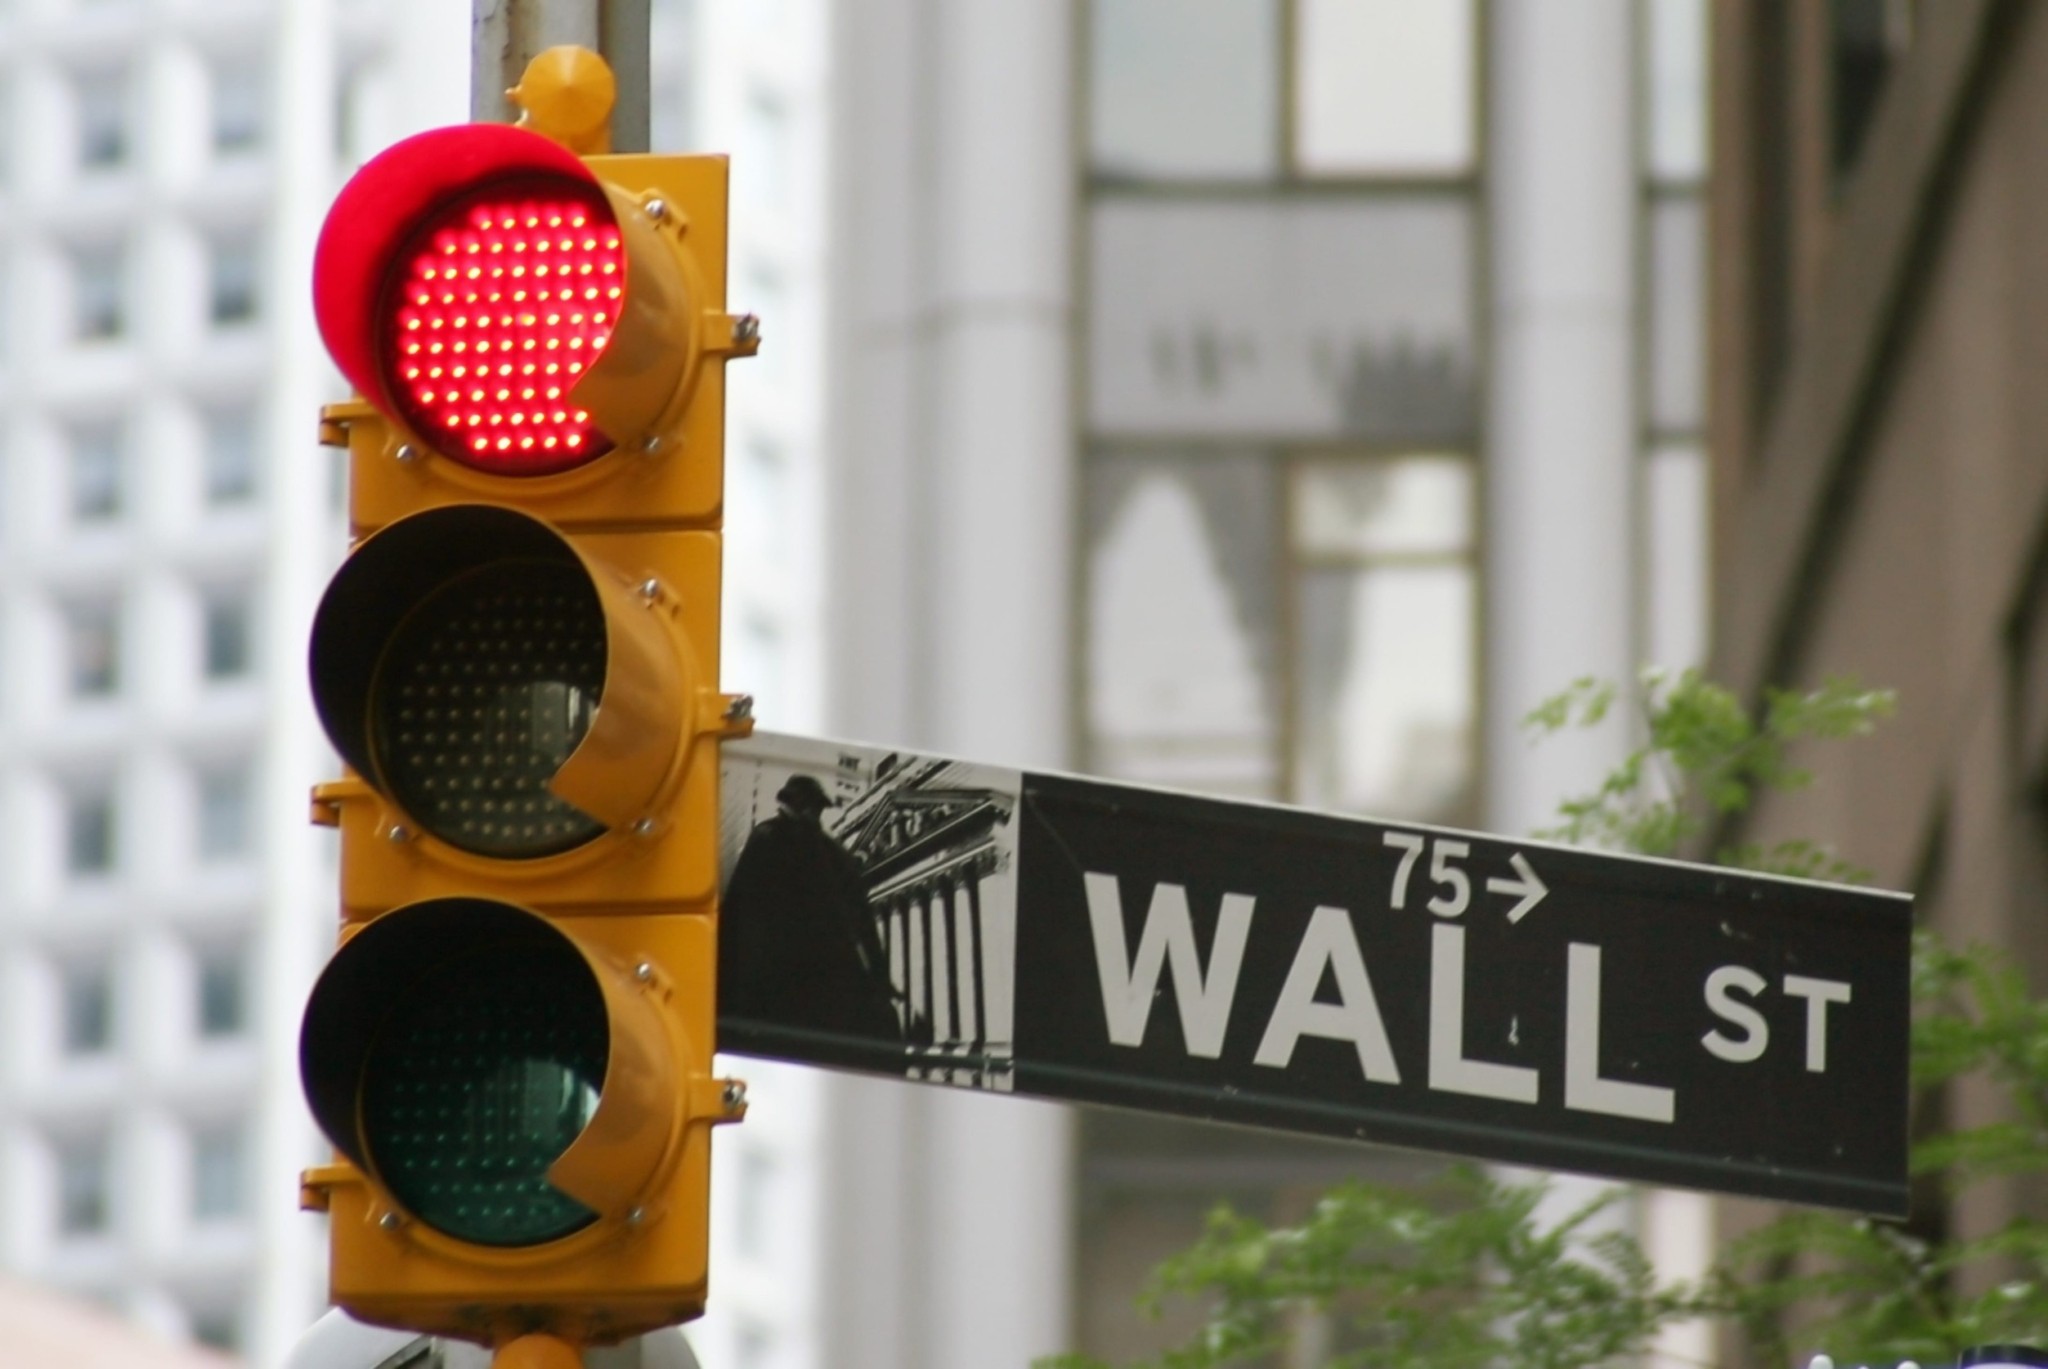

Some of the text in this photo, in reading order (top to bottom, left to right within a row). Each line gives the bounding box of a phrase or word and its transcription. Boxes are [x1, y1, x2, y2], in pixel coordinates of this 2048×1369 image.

[1383, 831, 1471, 918] 75
[1084, 872, 1852, 1123] WALL ST
